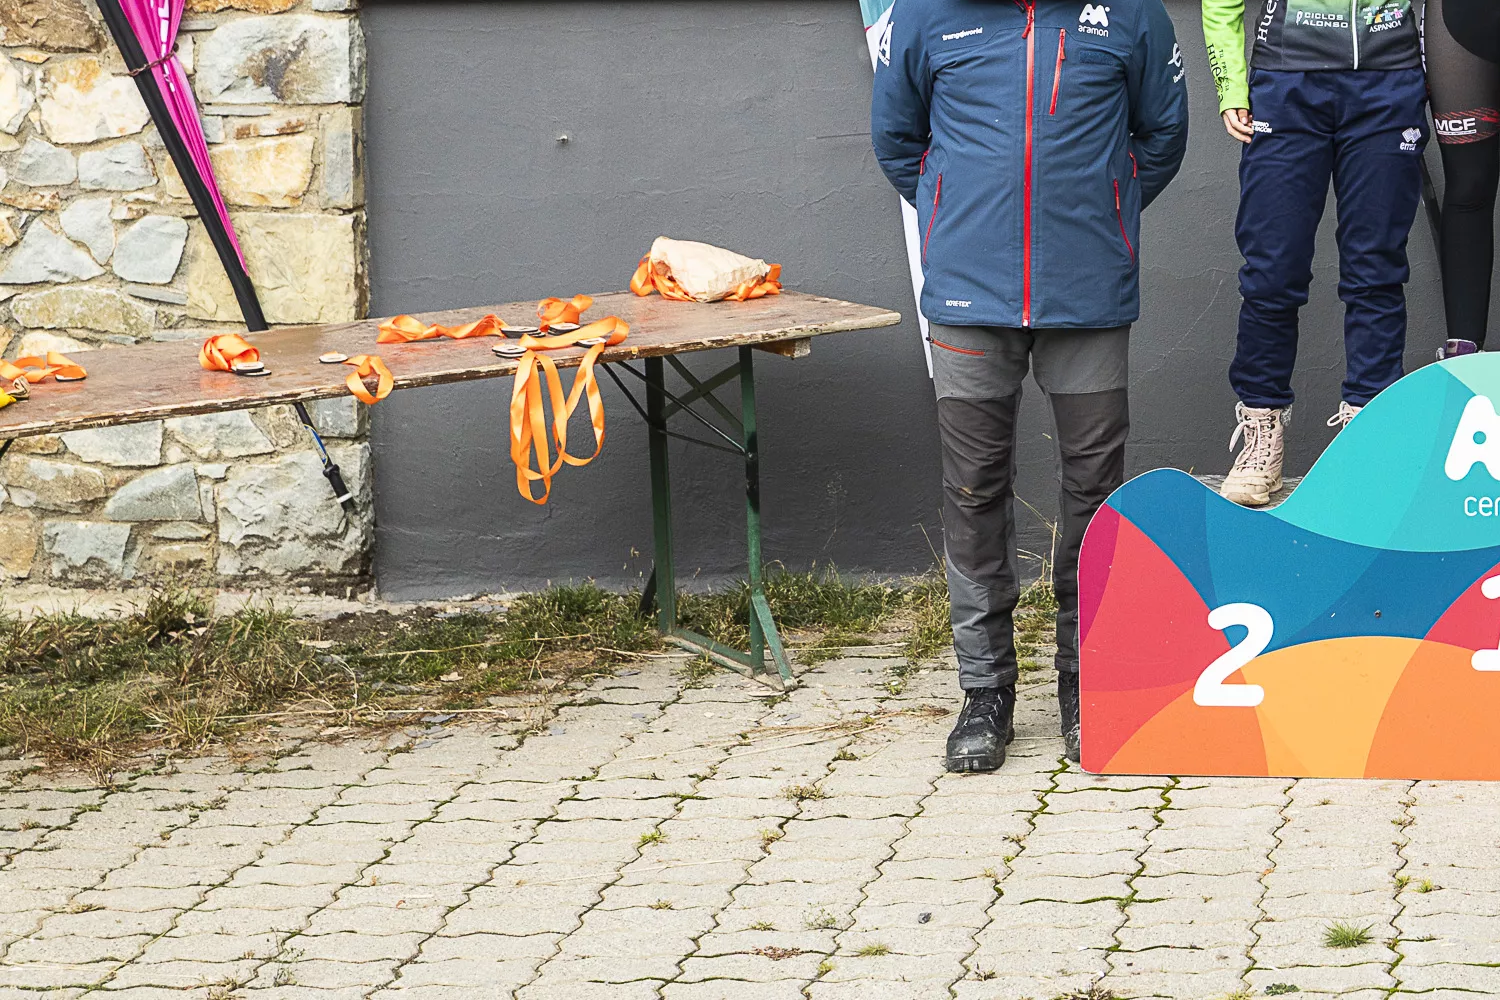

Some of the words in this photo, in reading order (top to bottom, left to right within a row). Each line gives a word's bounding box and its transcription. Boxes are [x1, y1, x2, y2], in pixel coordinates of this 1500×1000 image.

[1304, 12, 1344, 21] CICLOS
[1077, 24, 1109, 38] aramon
[1302, 20, 1349, 29] ALONSO
[1434, 118, 1476, 132] MCF
[1192, 602, 1275, 708] 2
